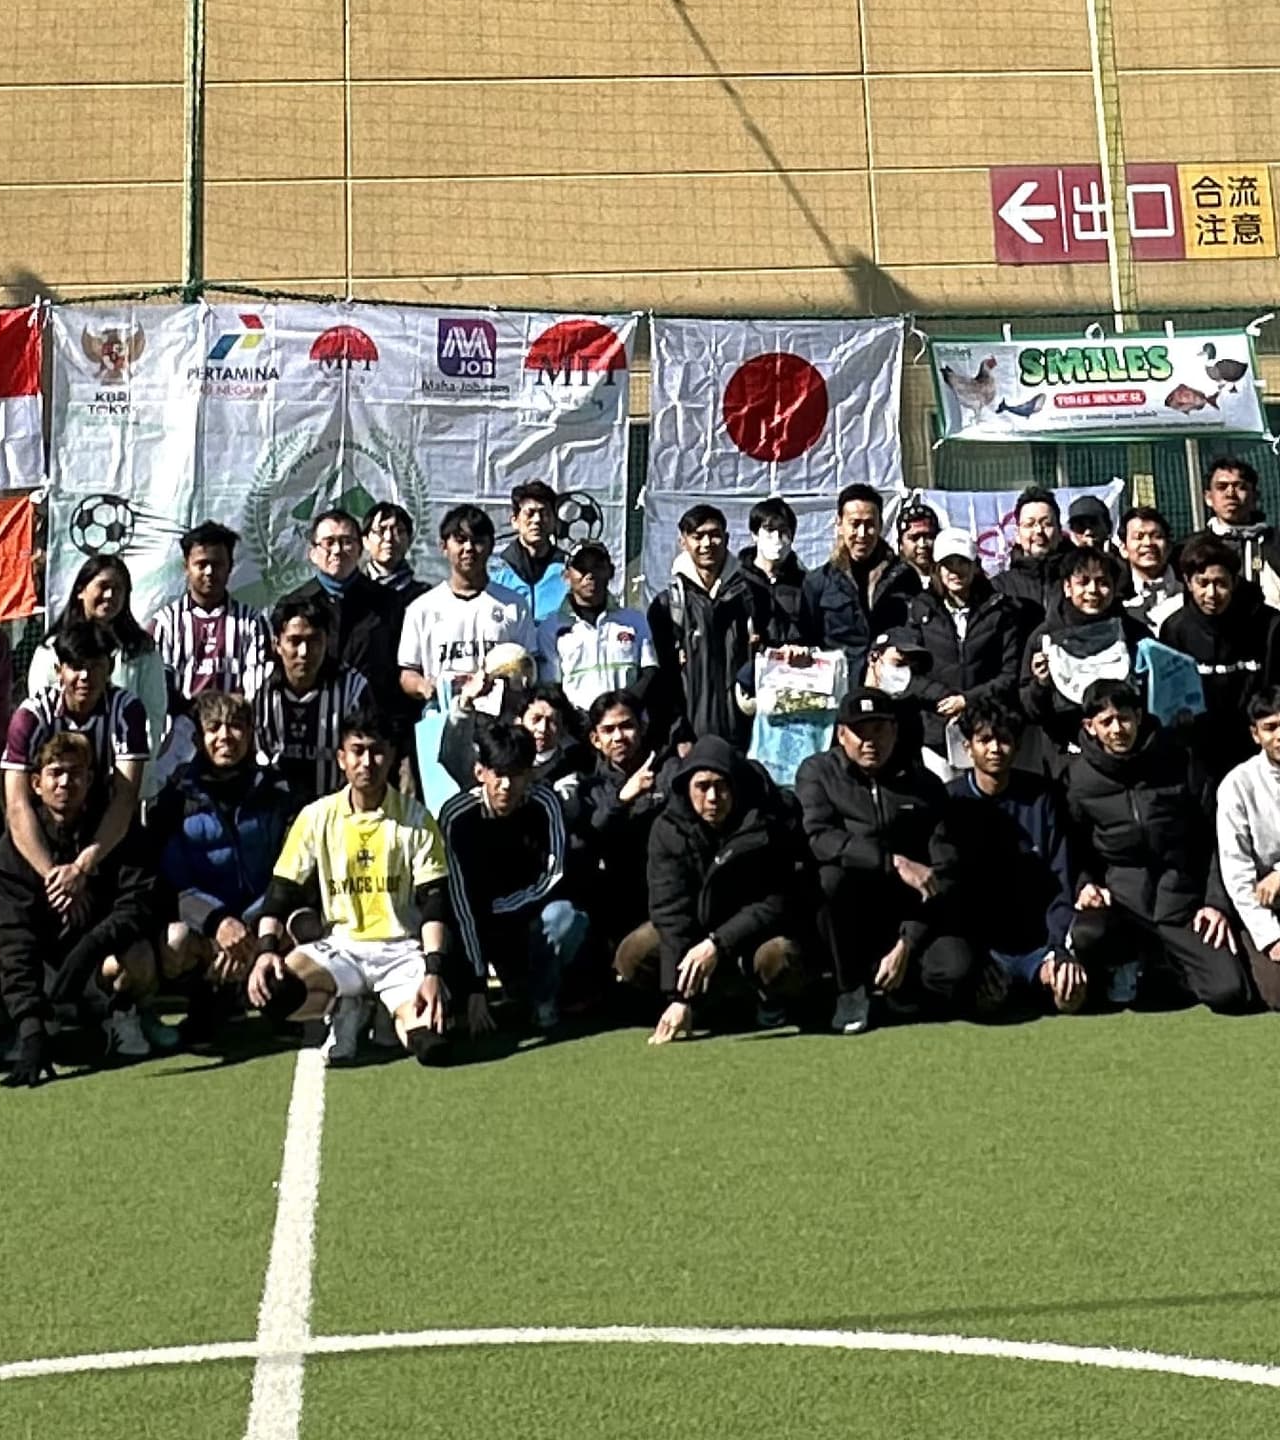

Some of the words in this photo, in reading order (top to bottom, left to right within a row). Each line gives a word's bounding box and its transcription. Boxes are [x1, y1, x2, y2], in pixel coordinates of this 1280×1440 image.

[1191, 175, 1261, 208] 合流
[1072, 181, 1176, 240] 出口
[1194, 212, 1265, 247] 注意
[186, 366, 280, 381] PERTAMINA
[457, 361, 494, 375] JOB
[1019, 345, 1174, 387] SMILES
[87, 403, 137, 415] TOKY
